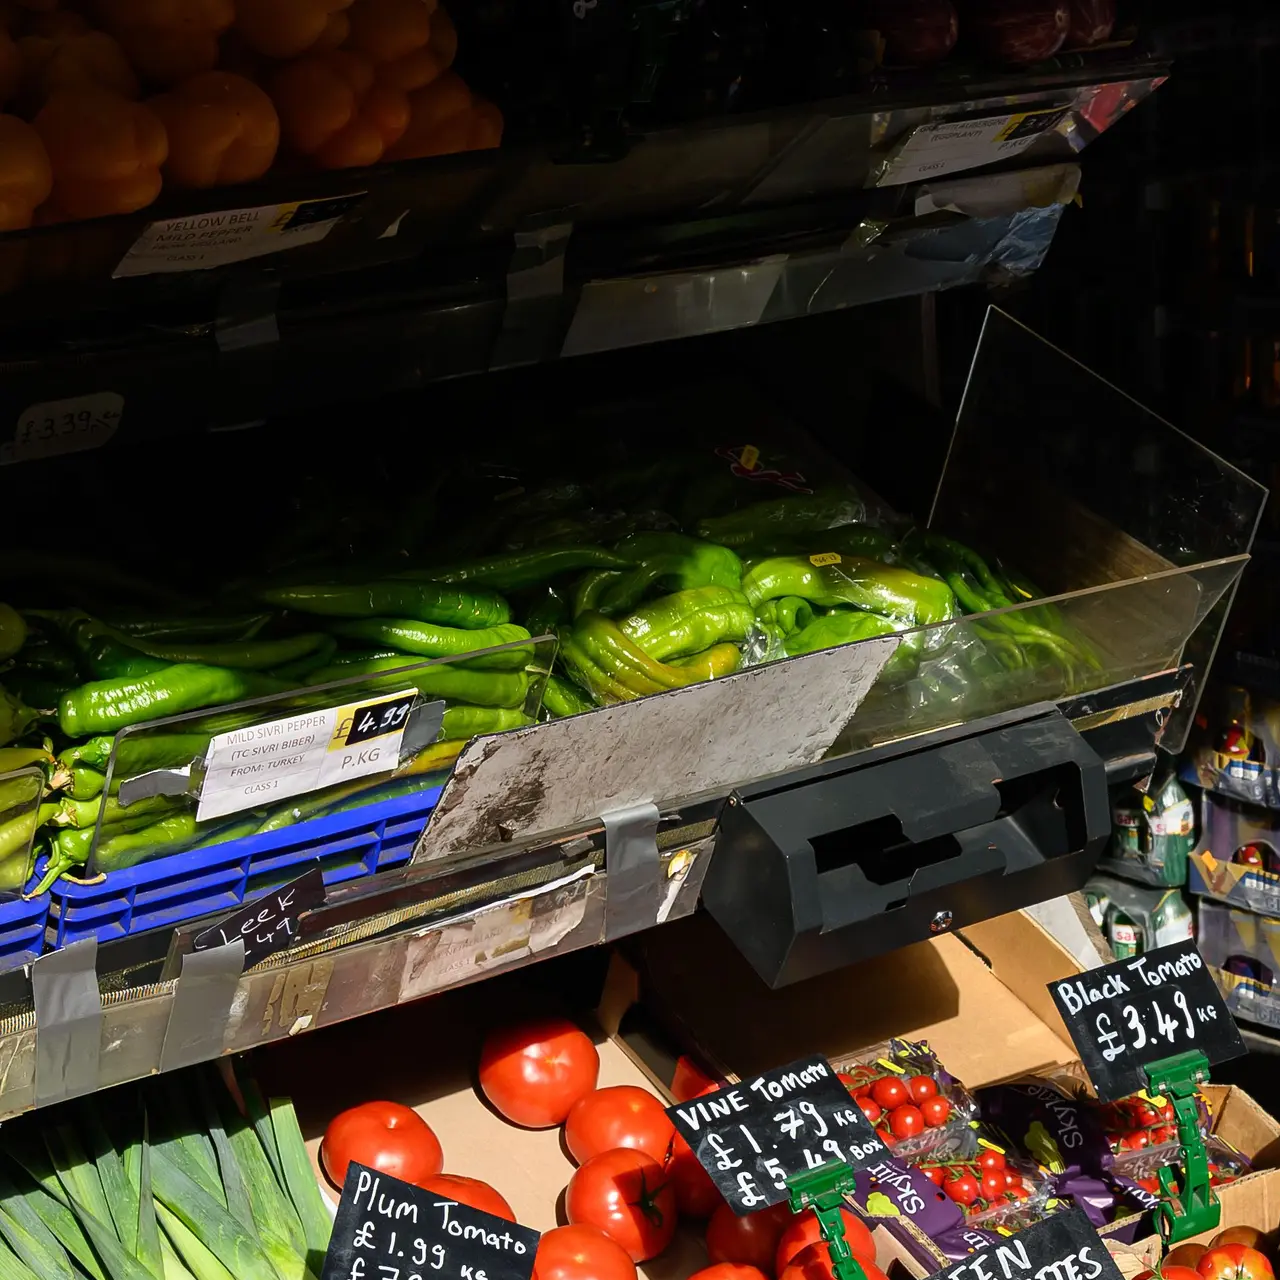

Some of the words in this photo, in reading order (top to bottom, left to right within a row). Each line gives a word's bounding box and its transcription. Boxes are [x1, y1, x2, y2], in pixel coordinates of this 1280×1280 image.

[155, 233, 196, 243] MILD
[200, 225, 254, 240] PEPPER
[165, 215, 223, 232] YELLOW
[229, 211, 261, 225] BELL
[227, 732, 255, 746] MILD
[256, 724, 285, 740] SIVRI
[286, 714, 326, 732] PEPPER
[252, 742, 280, 757] SIVRI
[280, 734, 316, 750] BIBER)
[340, 747, 382, 770] P.KG
[230, 763, 265, 777] FROM:
[266, 754, 305, 770] TURKEY
[243, 783, 274, 796] CLASS
[218, 888, 298, 946] Leek
[1057, 973, 1131, 1016] Black
[1127, 952, 1203, 987] Tomato
[1095, 990, 1196, 1062] £3.49
[1196, 1004, 1218, 1023] KG
[676, 1090, 750, 1131] VINE
[832, 1109, 859, 1128] KG
[352, 1170, 418, 1225] Plum
[433, 1201, 528, 1255] Tomato
[352, 1220, 446, 1270] £1.99
